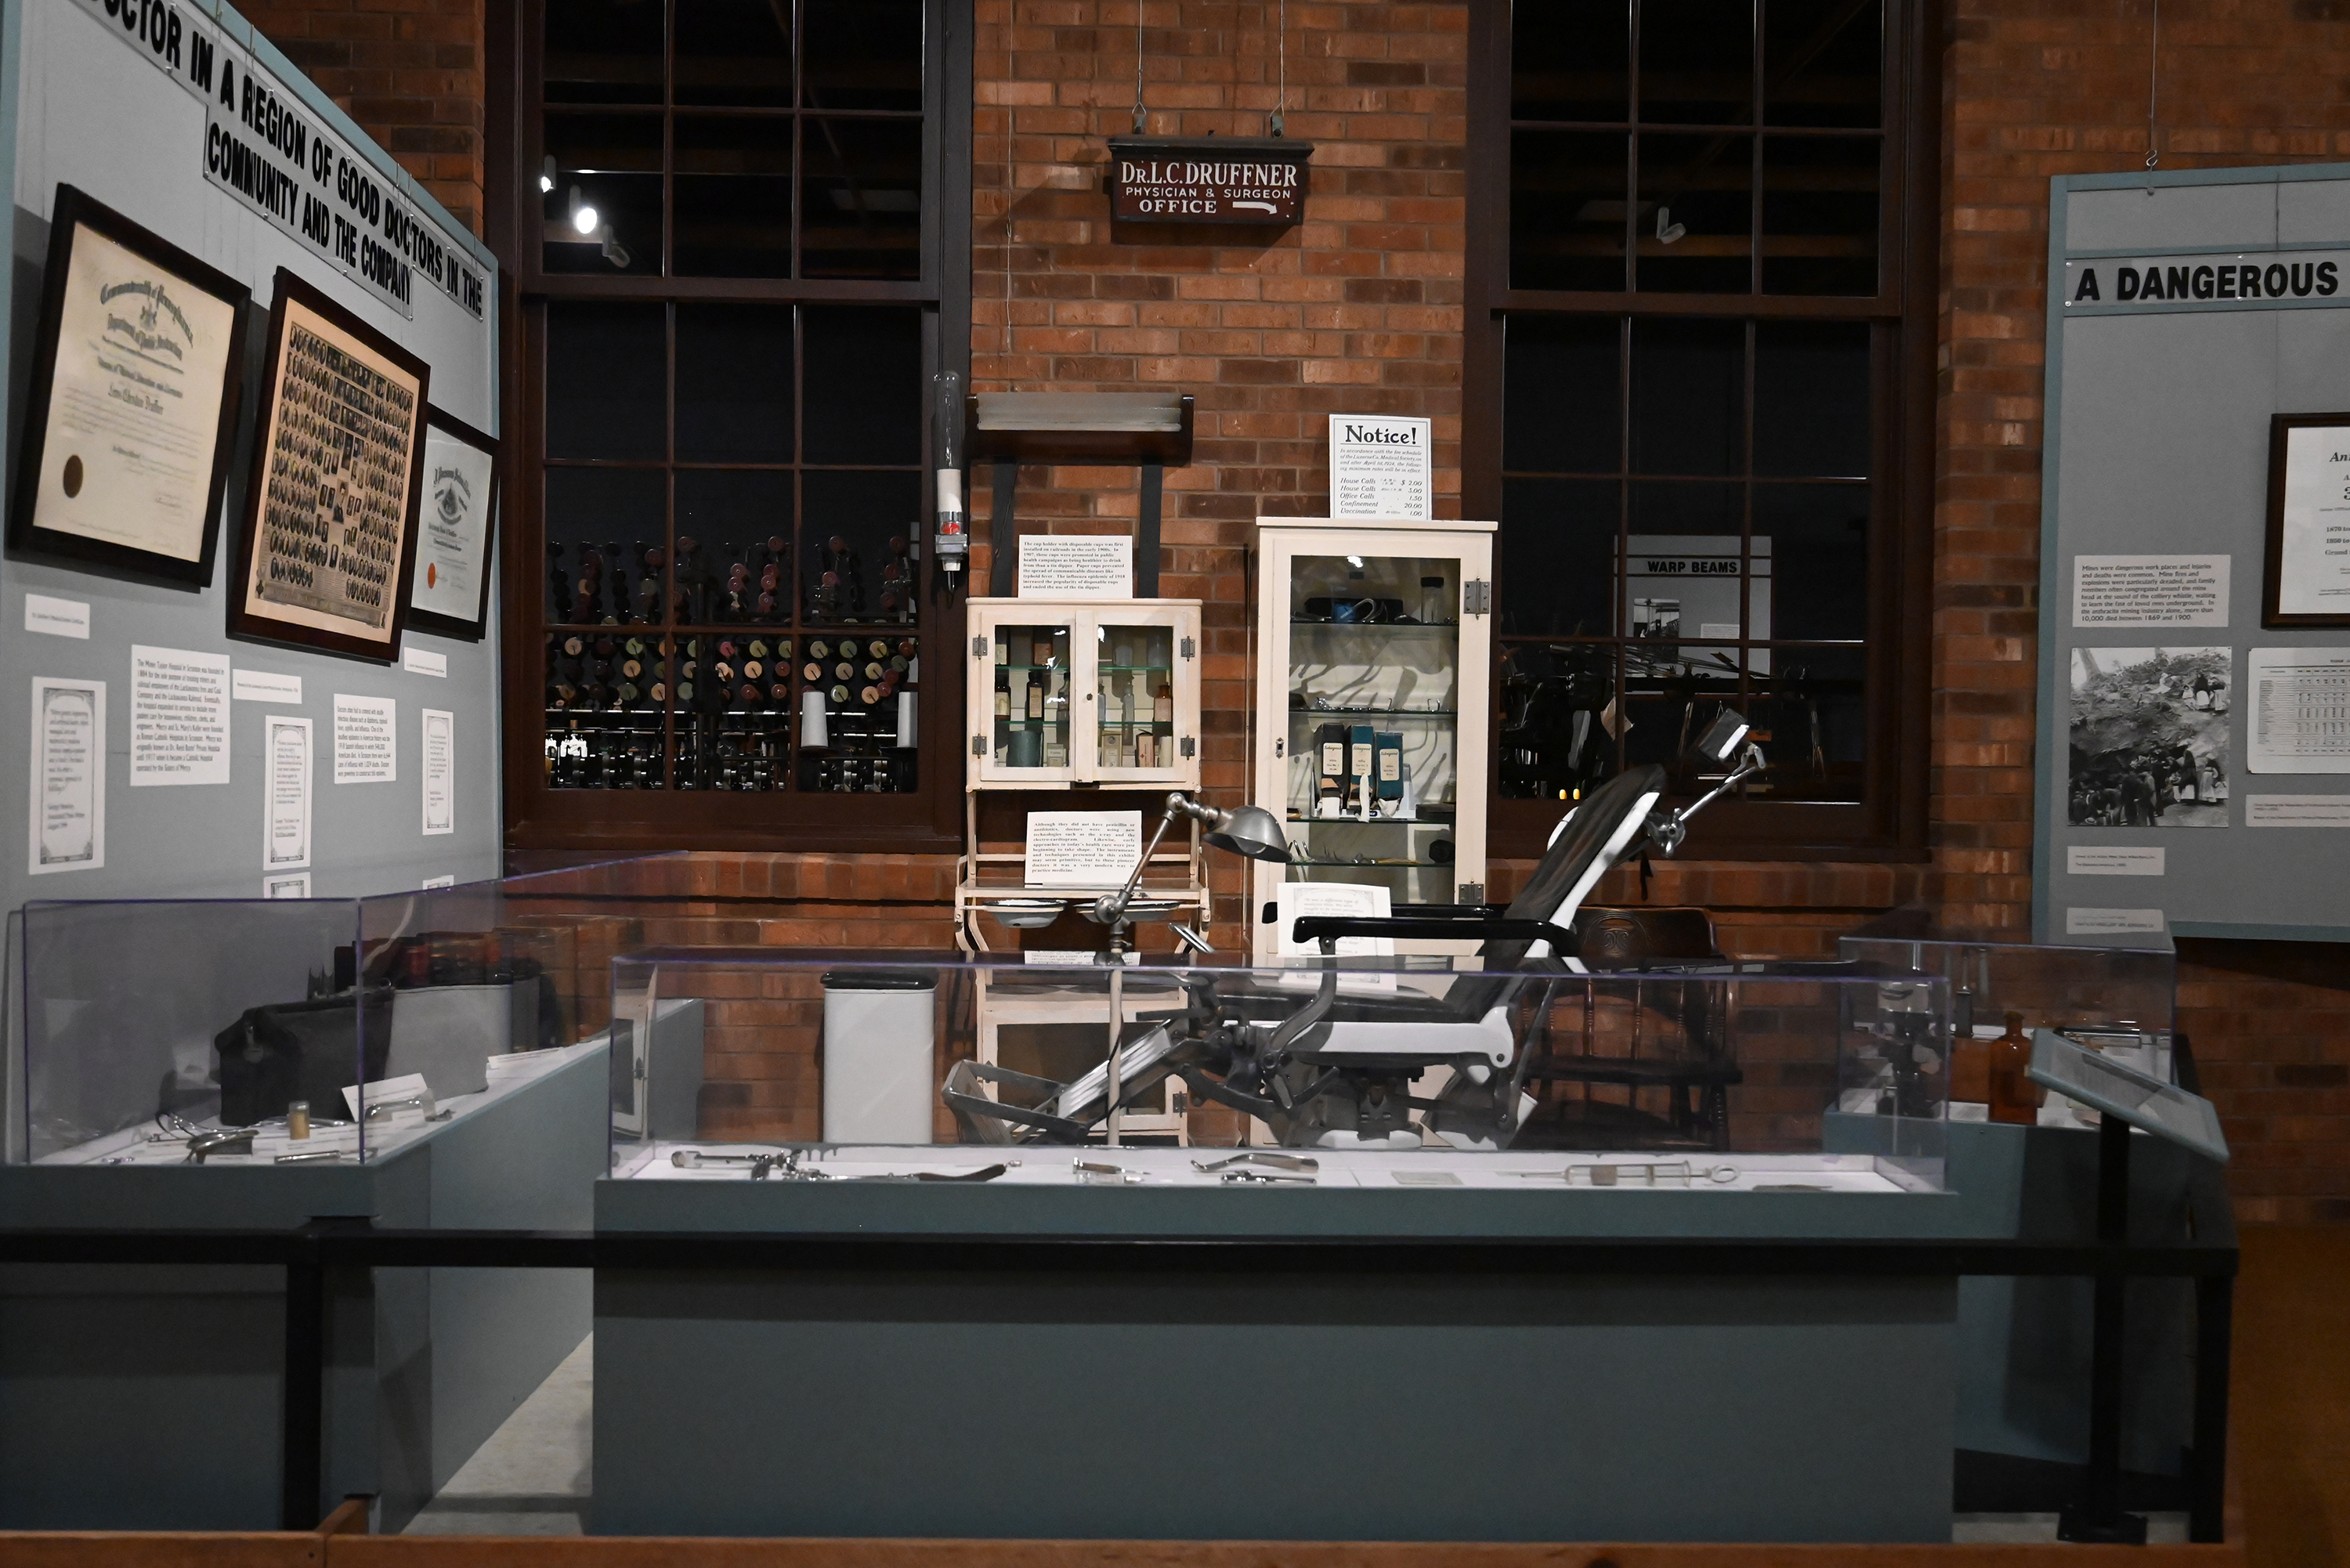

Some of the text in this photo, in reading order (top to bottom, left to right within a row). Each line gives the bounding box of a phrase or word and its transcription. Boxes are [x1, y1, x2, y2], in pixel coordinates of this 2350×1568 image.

[190, 31, 213, 93] IN
[220, 59, 234, 113] A
[241, 74, 306, 170] REGION
[313, 136, 333, 188] OF
[338, 157, 380, 227] GOOD
[384, 197, 443, 283] DOCTORS
[447, 255, 459, 298] IN
[462, 268, 483, 316] THE
[1126, 187, 1291, 199] PHYSICIAN & SURGEON
[208, 122, 411, 305] COMMUNITY AND THE COMPANY
[1139, 199, 1217, 214] OFFICE
[2075, 262, 2338, 301] A DANGEROUS
[1345, 425, 1416, 445] Notice!
[1647, 561, 1737, 573] WARP BEAMS
